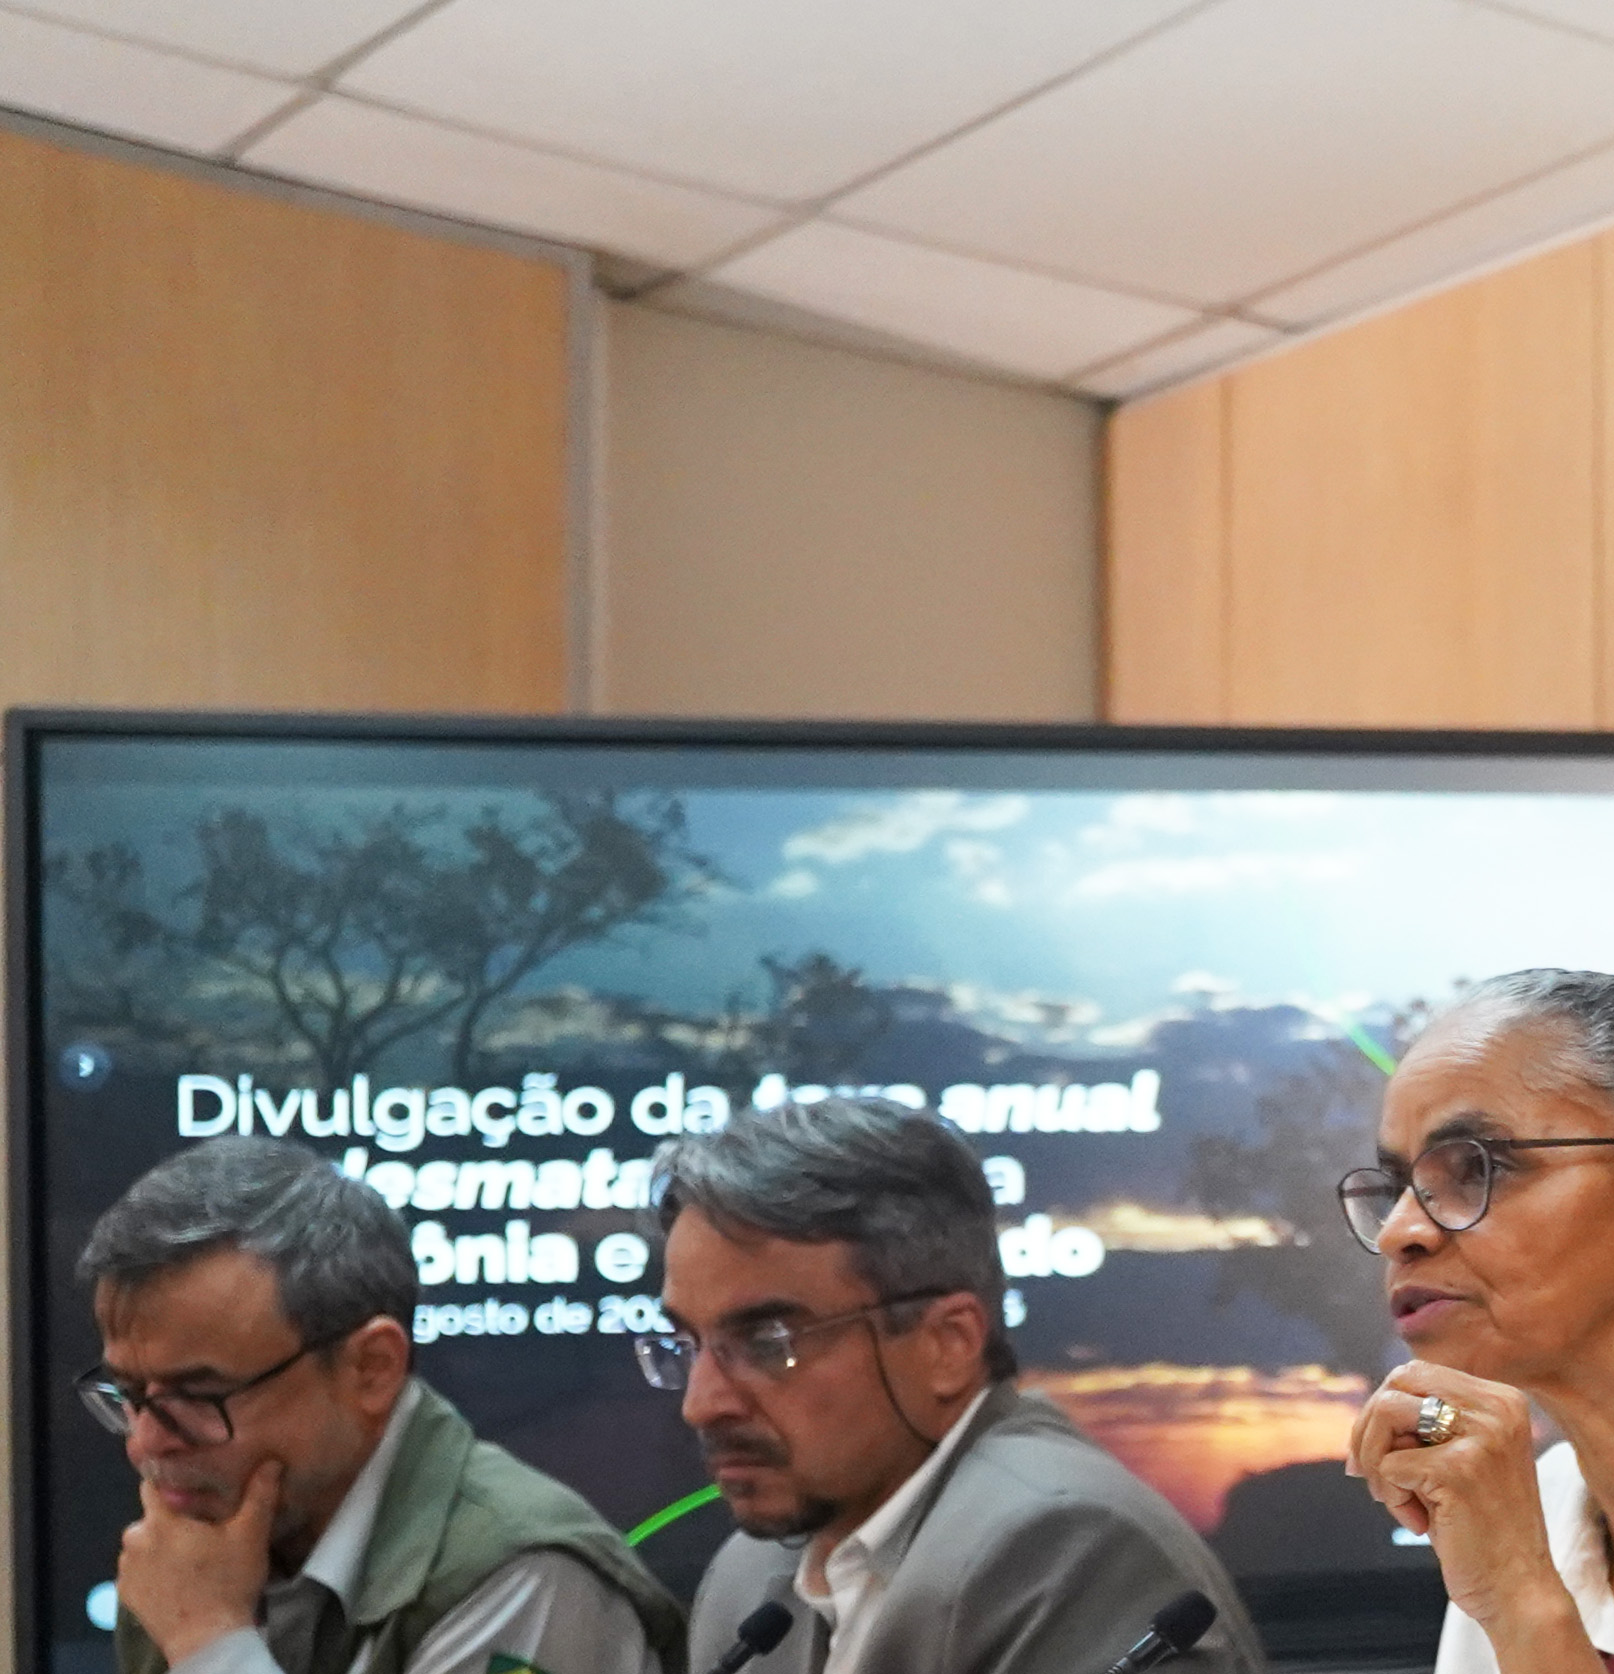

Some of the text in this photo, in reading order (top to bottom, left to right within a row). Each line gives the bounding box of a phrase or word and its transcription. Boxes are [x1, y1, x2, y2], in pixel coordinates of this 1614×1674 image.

[178, 1073, 615, 1152] Divulgação
[631, 1071, 729, 1135] da
[938, 1068, 1162, 1134] anual
[411, 1218, 650, 1285] ônia e
[412, 1296, 530, 1345] gosto
[533, 1294, 594, 1335] de
